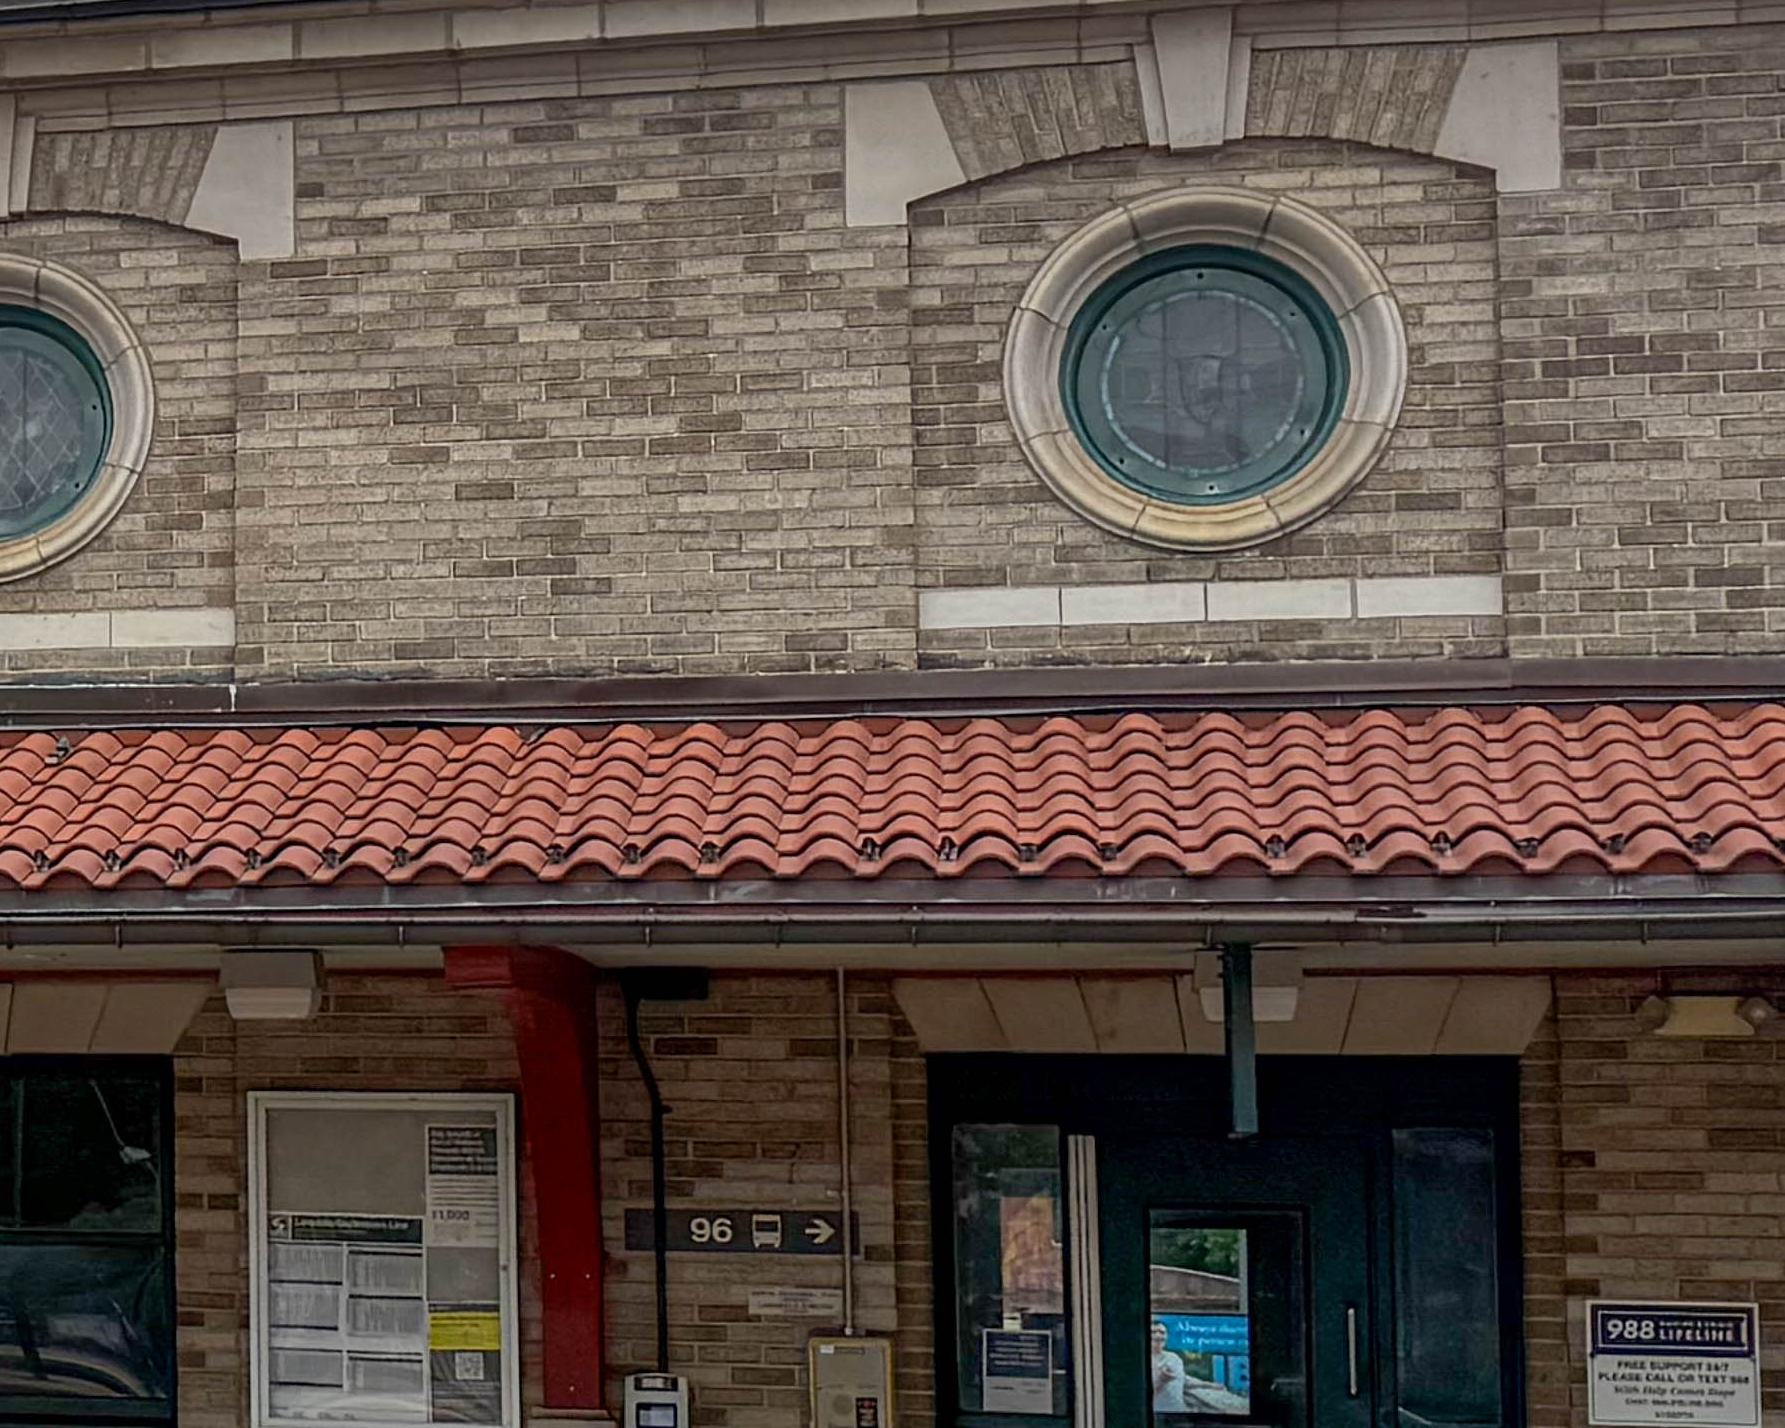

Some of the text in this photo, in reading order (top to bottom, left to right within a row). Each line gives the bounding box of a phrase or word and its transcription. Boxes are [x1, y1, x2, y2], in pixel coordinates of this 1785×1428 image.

[690, 1217, 733, 1243] 96
[1607, 1319, 1655, 1340] 988
[1649, 1361, 1702, 1372] SUPPORT
[1598, 1372, 1642, 1382] PLEASE
[1645, 1373, 1674, 1383] CALL
[1698, 1375, 1726, 1384] TEXT
